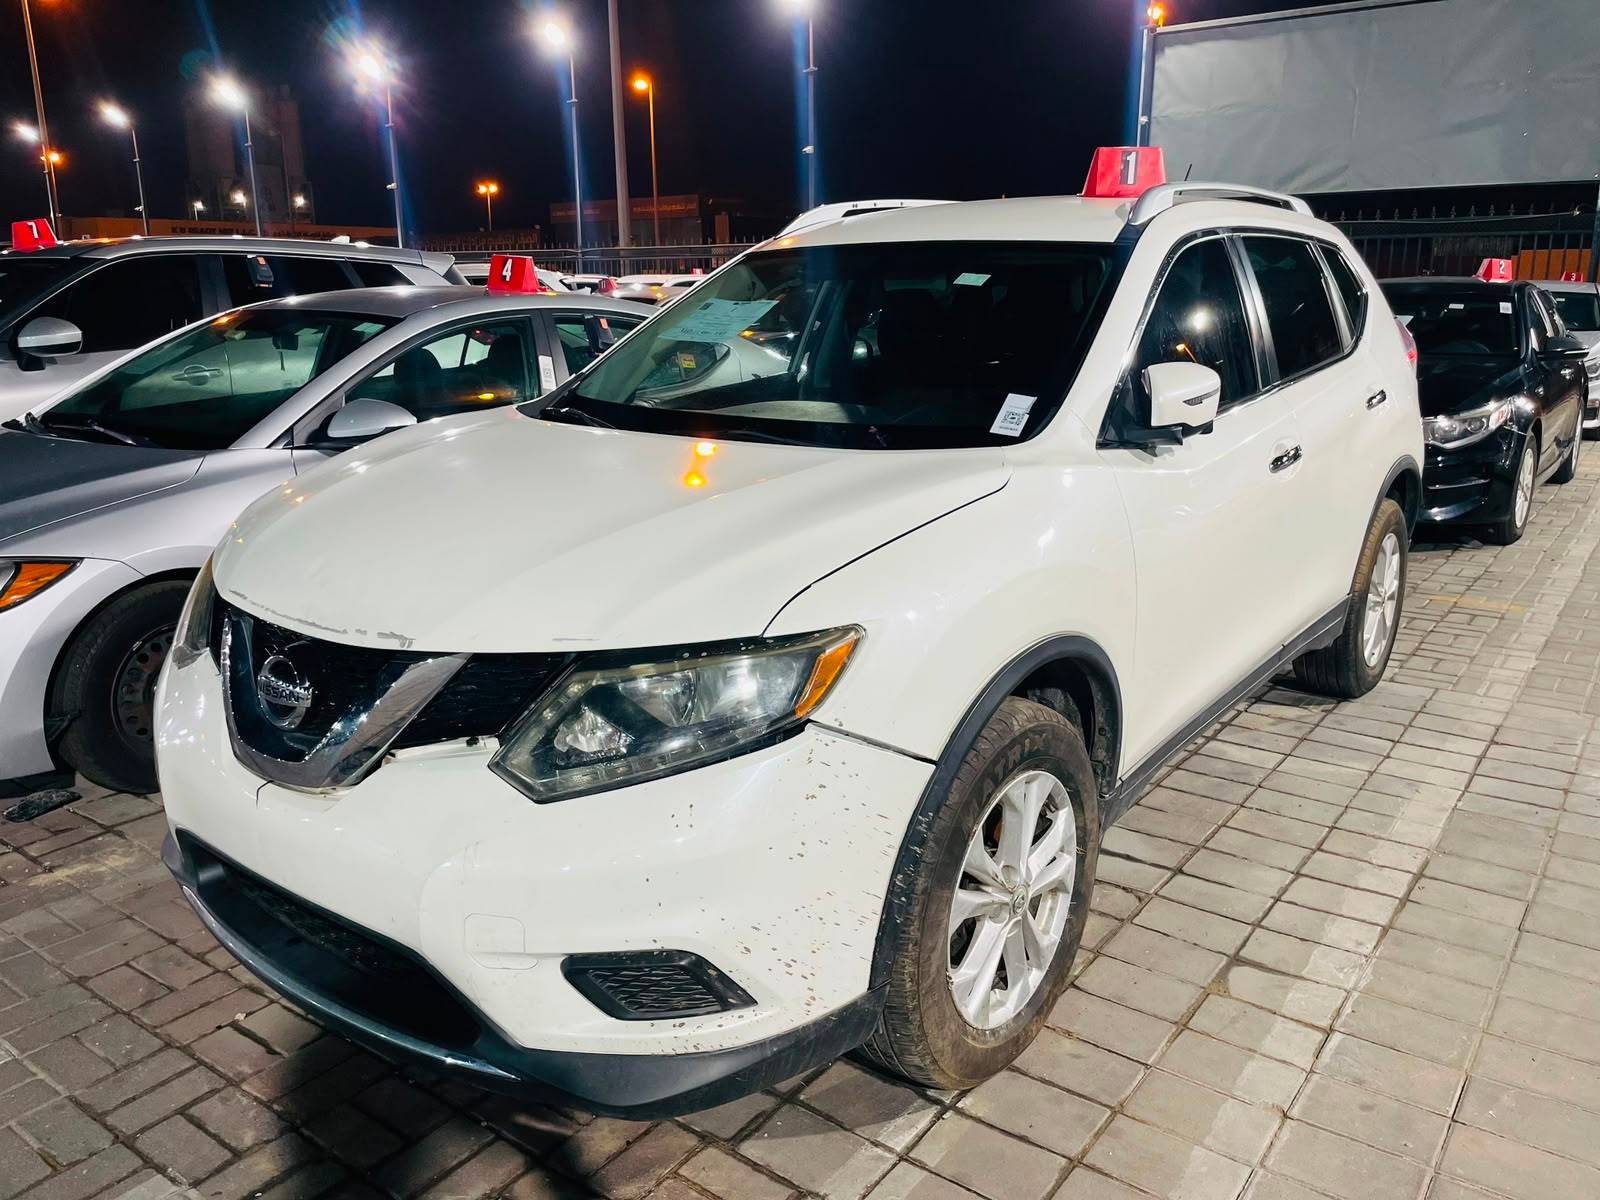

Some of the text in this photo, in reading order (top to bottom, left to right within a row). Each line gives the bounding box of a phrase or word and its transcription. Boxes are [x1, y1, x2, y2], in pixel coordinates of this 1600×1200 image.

[1126, 150, 1137, 185] 1
[502, 258, 513, 282] 4
[1499, 260, 1505, 274] 2
[1570, 272, 1576, 281] 3
[257, 678, 300, 703] NISSAN
